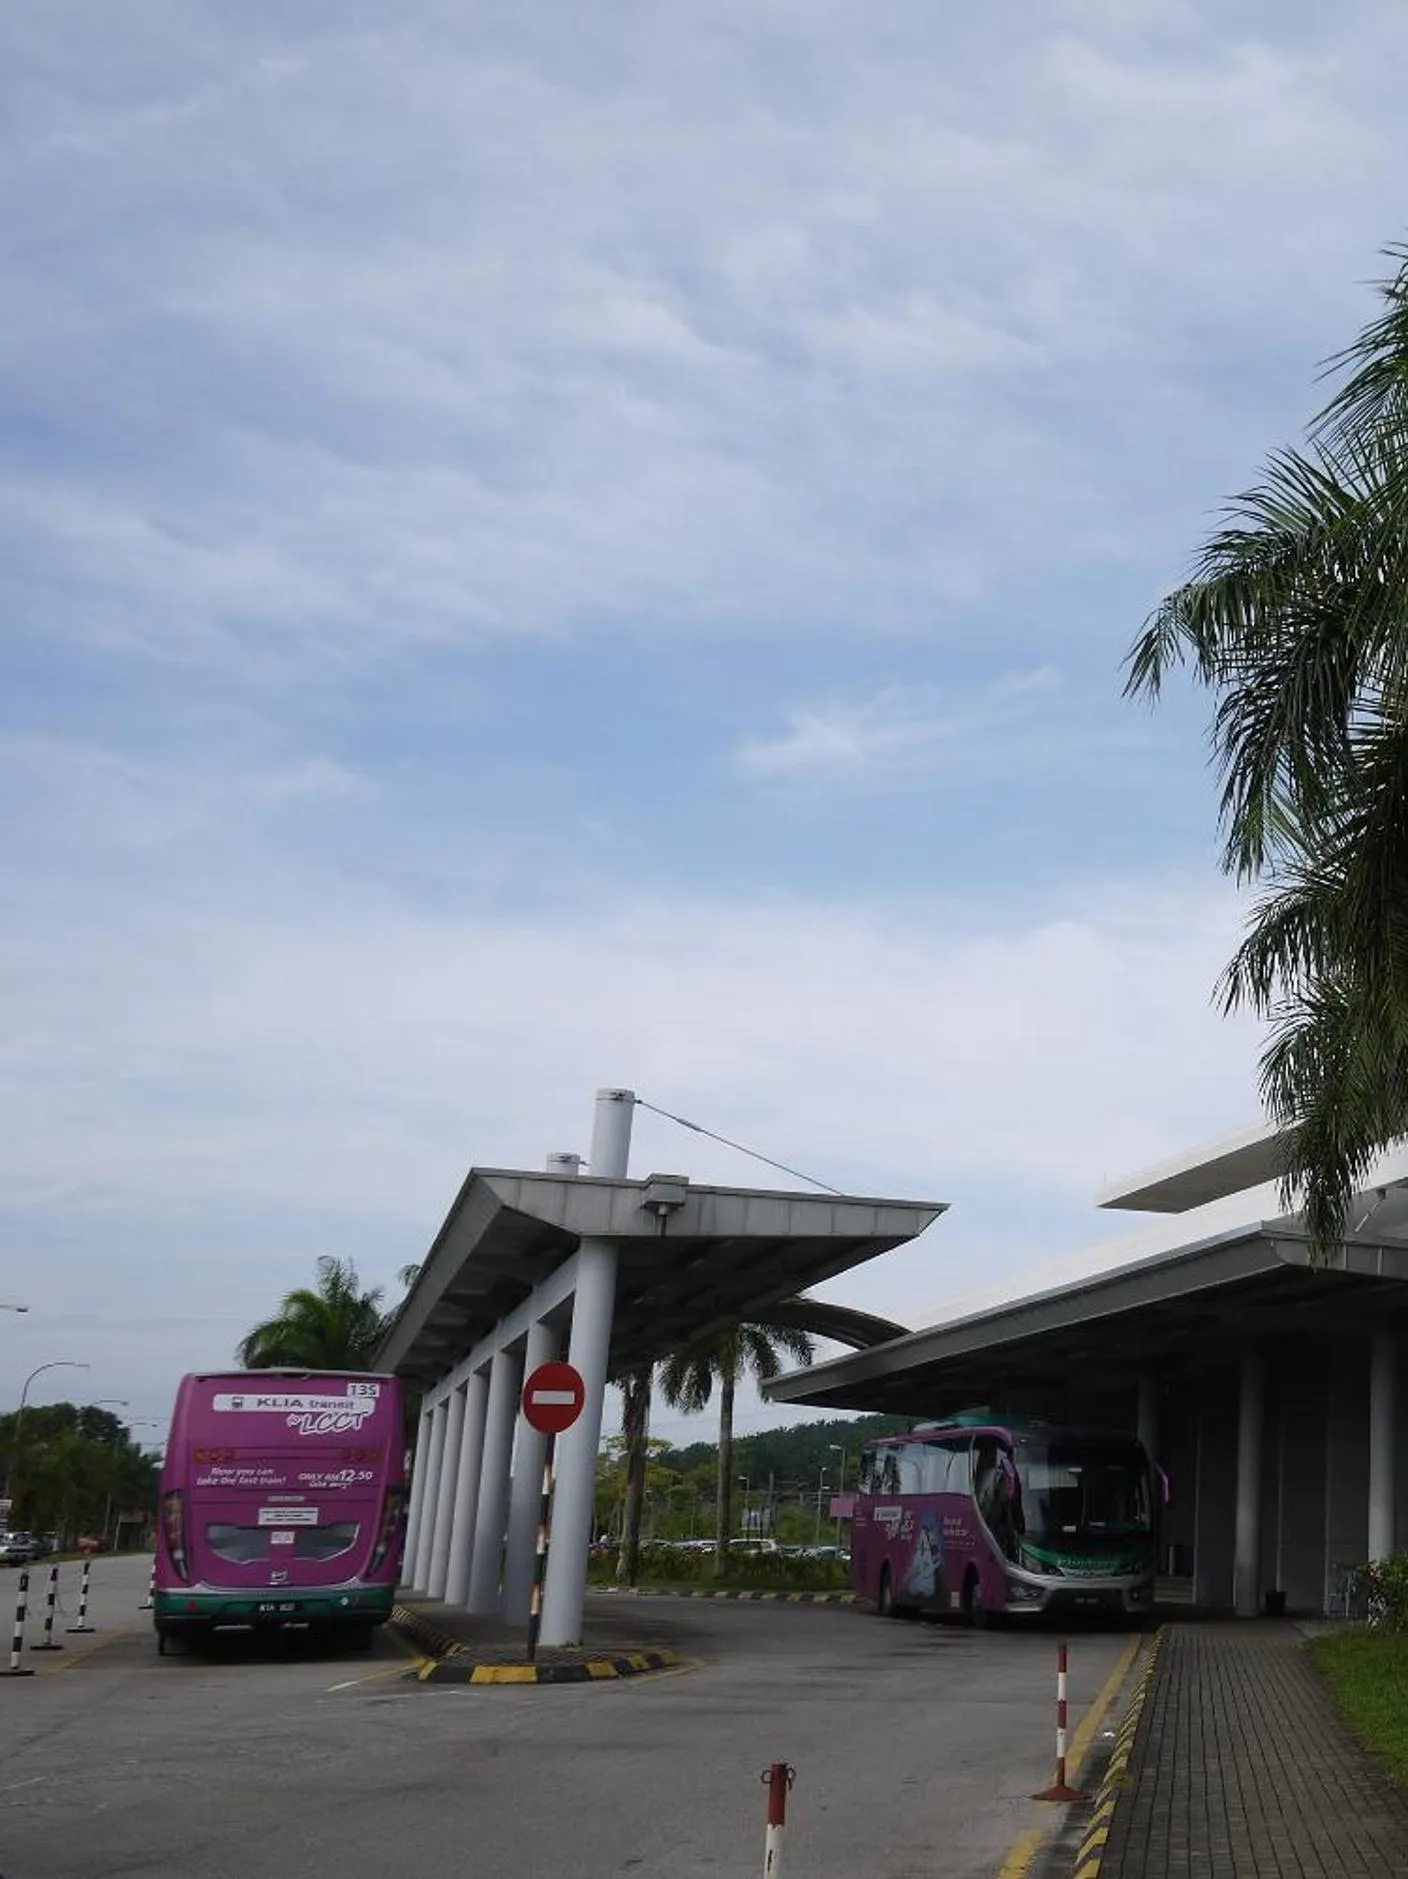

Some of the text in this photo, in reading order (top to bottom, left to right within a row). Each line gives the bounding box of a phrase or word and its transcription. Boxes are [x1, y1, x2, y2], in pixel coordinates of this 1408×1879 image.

[256, 1397, 355, 1409] KLIA transit
[300, 1411, 369, 1435] LCCT
